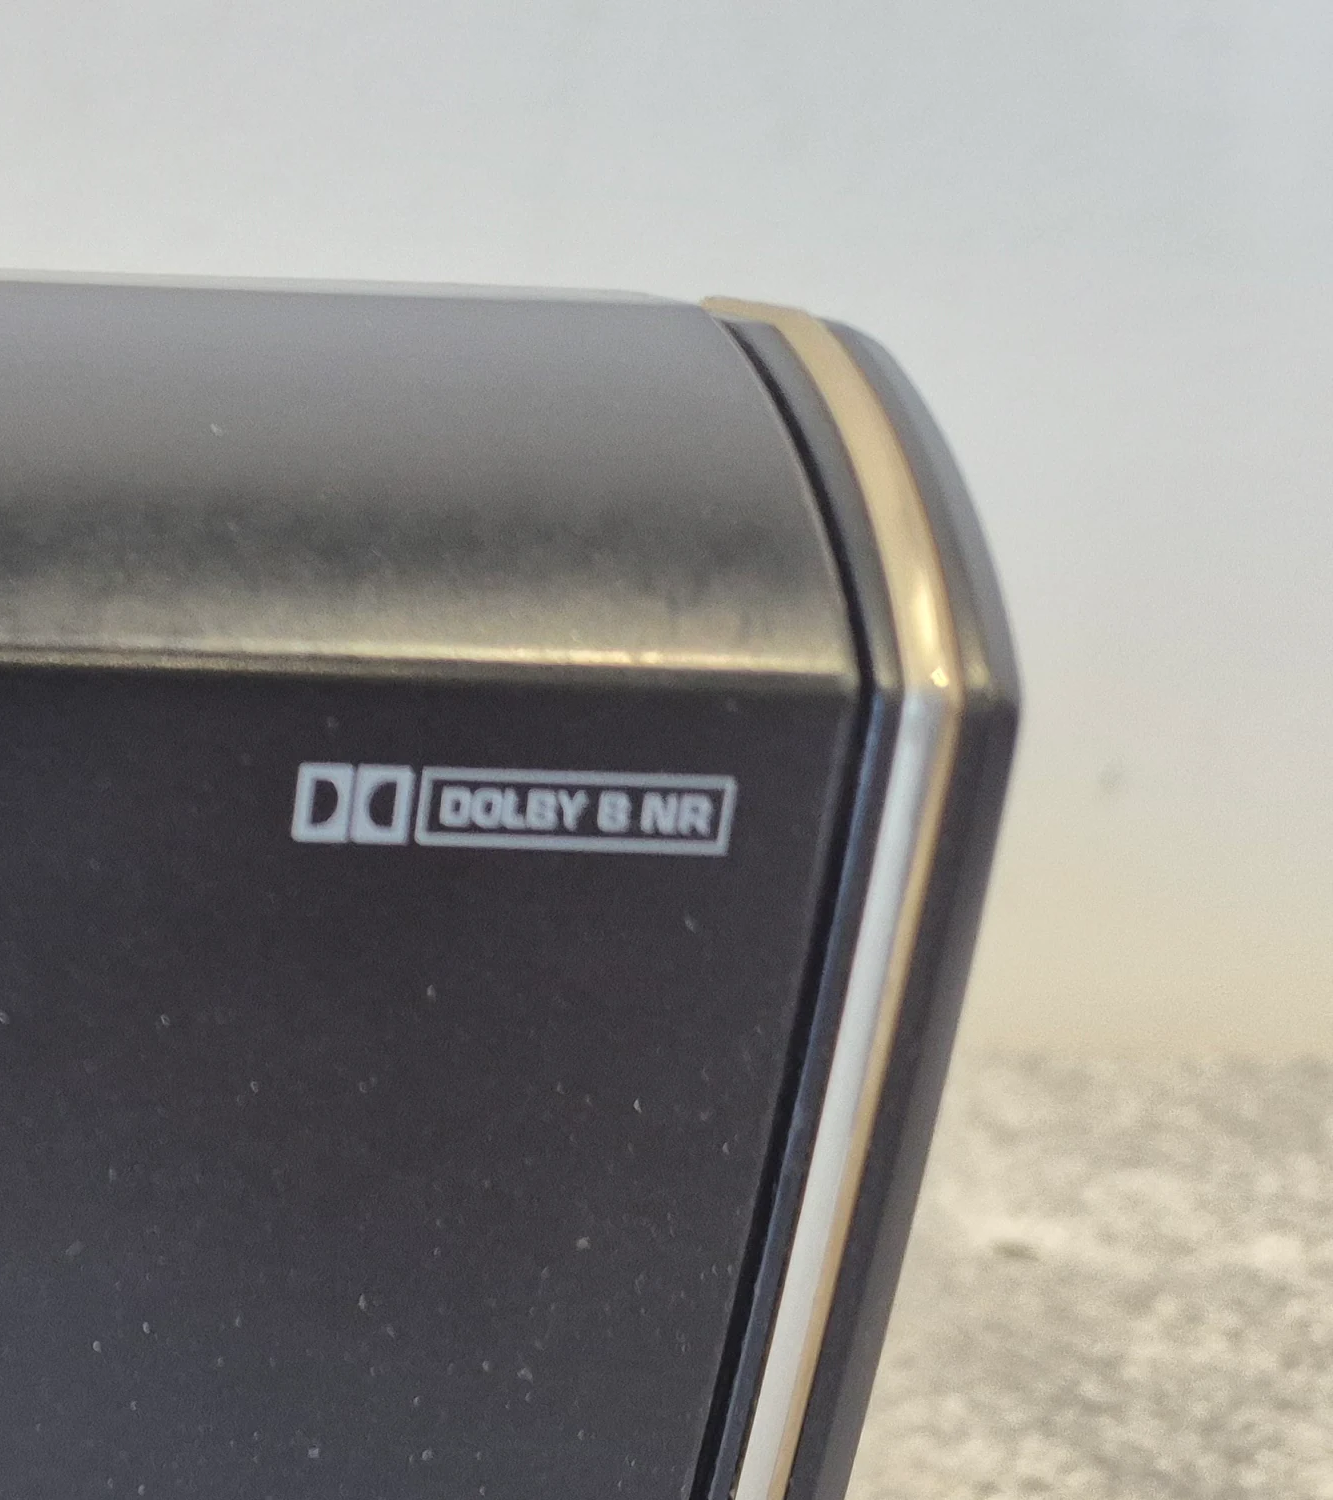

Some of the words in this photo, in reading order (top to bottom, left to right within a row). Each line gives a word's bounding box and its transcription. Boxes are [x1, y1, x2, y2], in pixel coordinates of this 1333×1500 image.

[439, 786, 588, 830] DOLBY
[596, 791, 632, 832] B
[640, 792, 713, 835] NR
